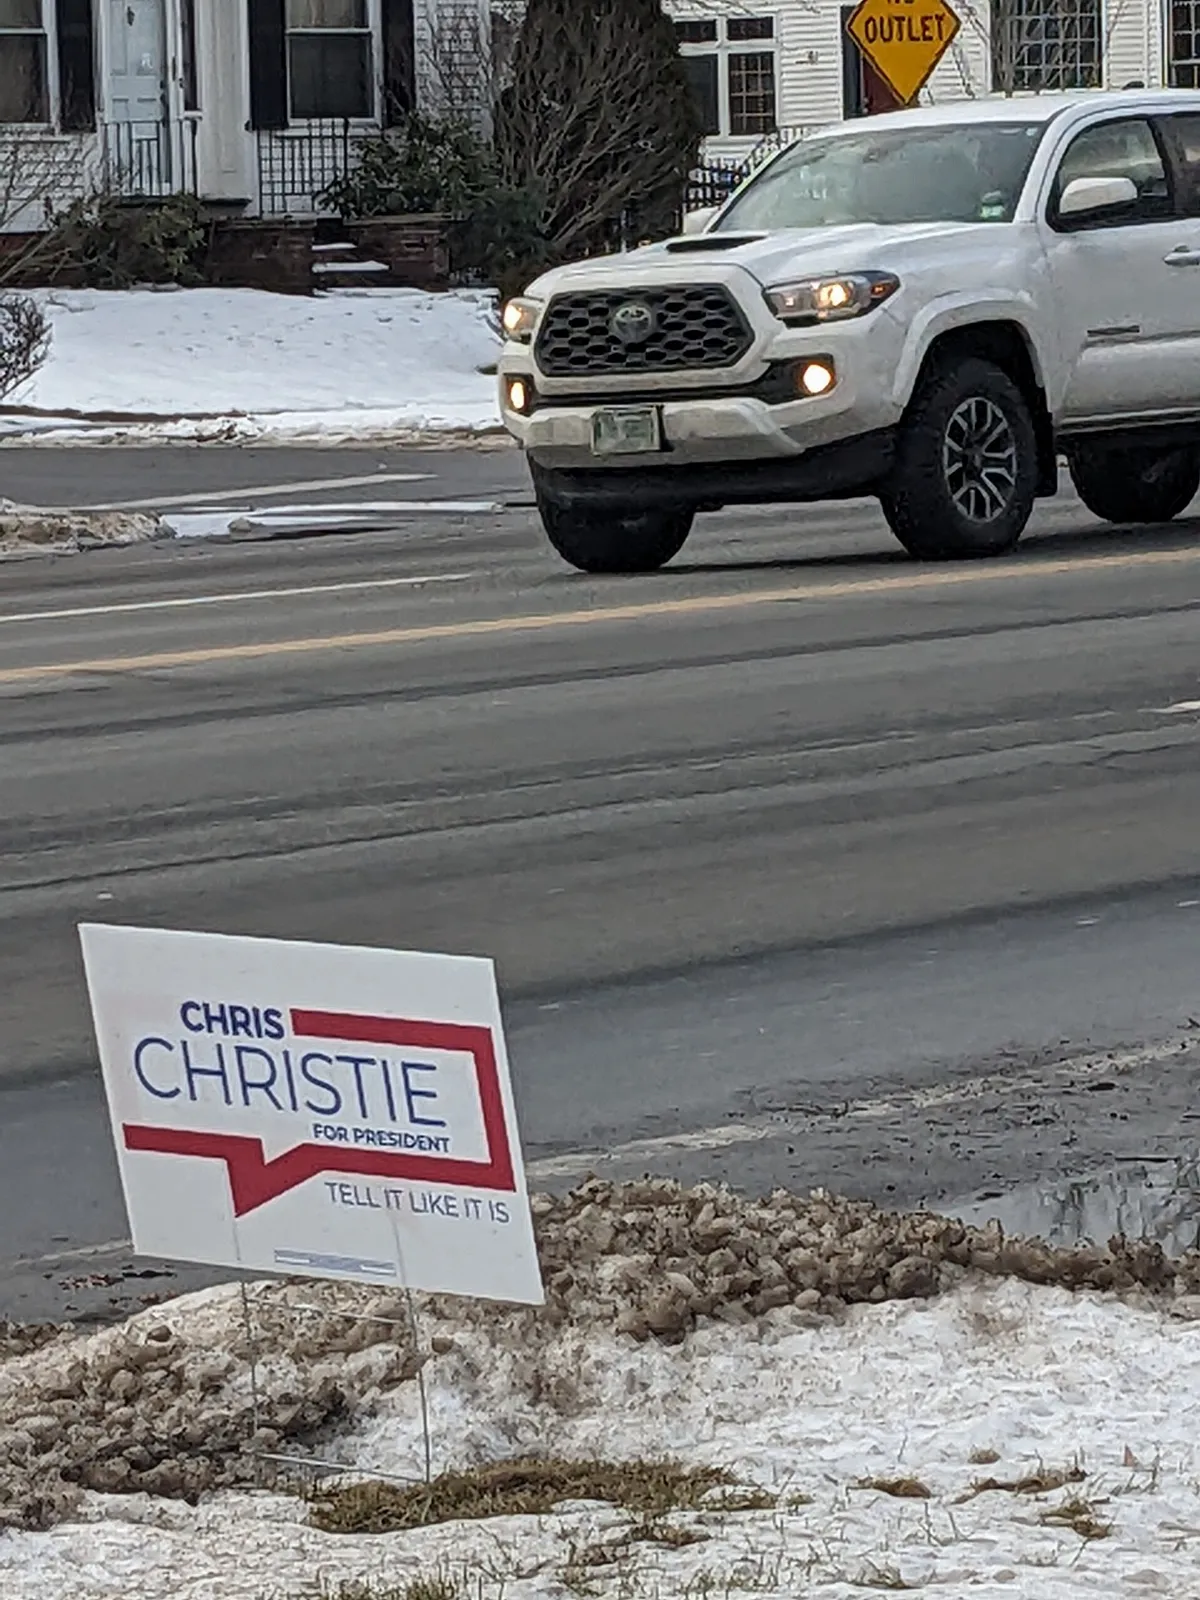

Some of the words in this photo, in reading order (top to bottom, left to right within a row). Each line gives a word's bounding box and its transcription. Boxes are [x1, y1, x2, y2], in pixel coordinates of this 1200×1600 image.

[864, 13, 945, 43] OUTLET
[181, 1001, 284, 1040] CHRIS
[134, 1037, 447, 1128] CHRISTIE
[313, 1123, 349, 1142] FOR
[354, 1128, 450, 1152] PRESIDENT
[324, 1182, 380, 1209] TELL
[385, 1190, 402, 1211] IT
[410, 1191, 459, 1217] LIKE
[465, 1199, 483, 1221] IT
[488, 1200, 510, 1223] IS
